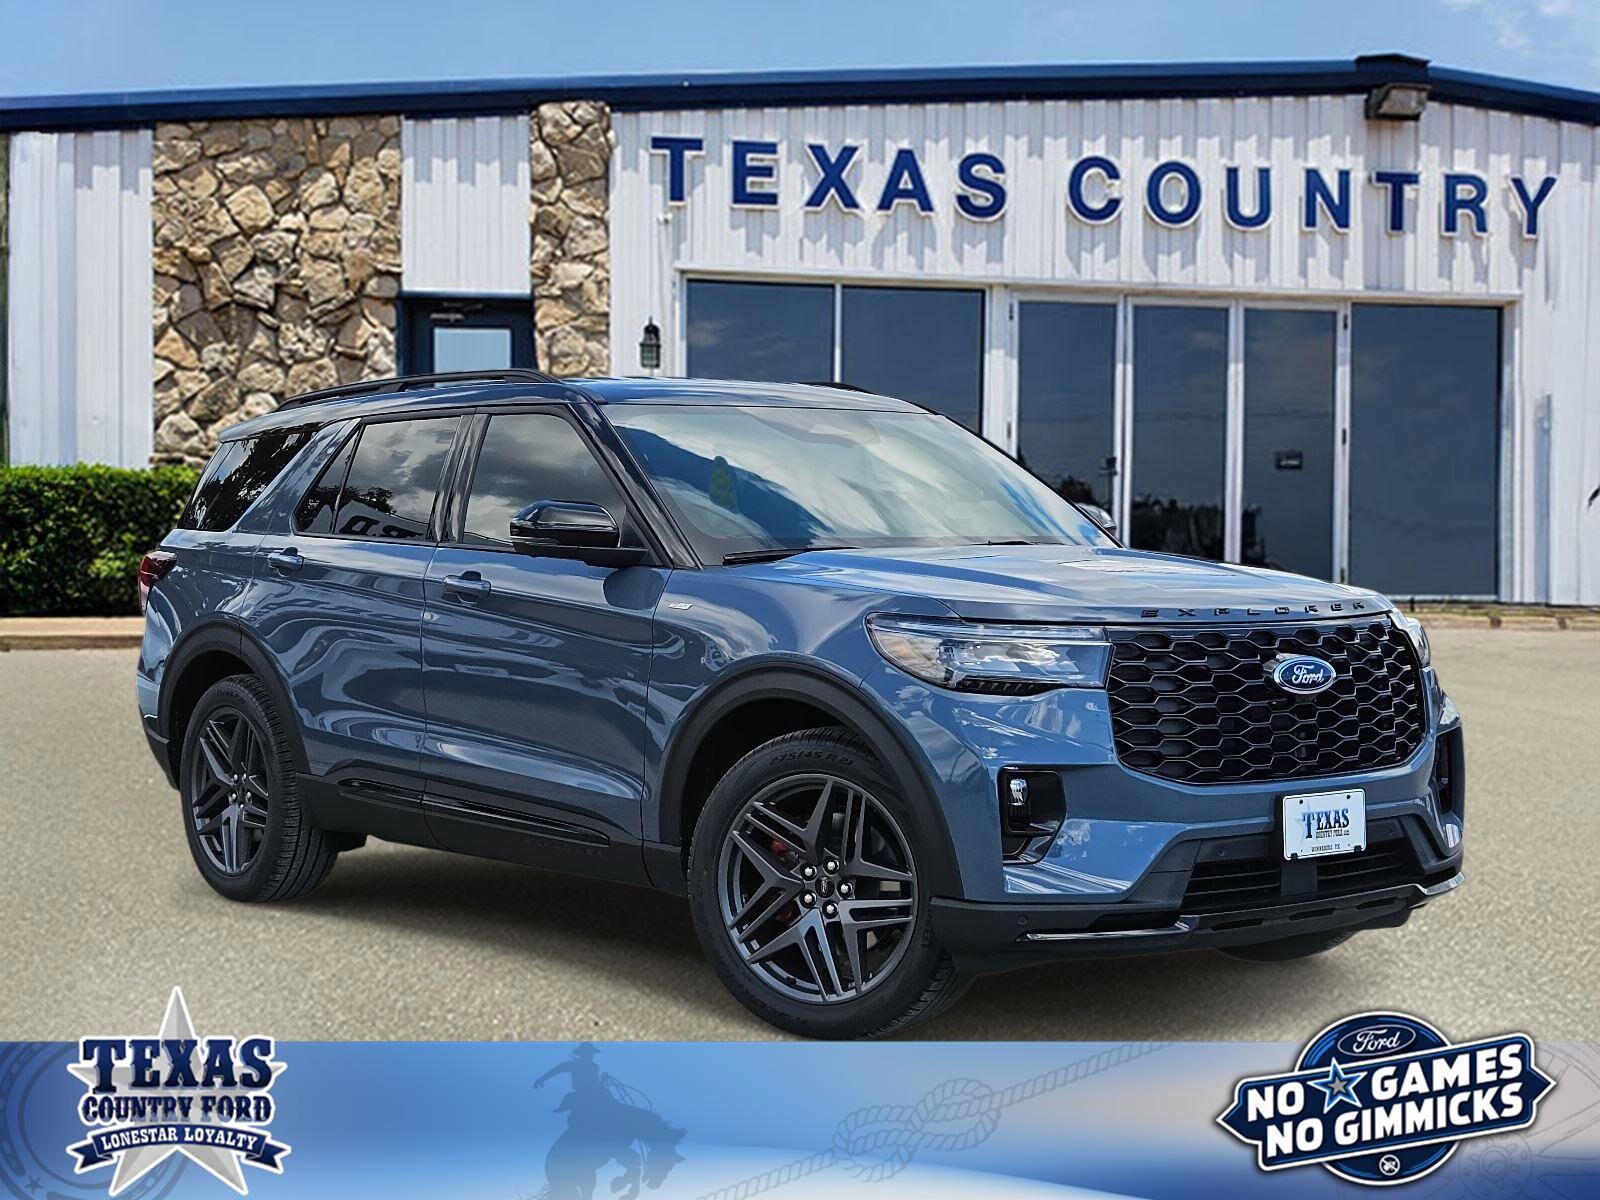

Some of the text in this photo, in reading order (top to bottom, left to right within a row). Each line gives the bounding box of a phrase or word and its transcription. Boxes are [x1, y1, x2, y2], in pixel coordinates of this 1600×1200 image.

[650, 135, 1558, 239] TEXAS COUNTRY
[1140, 601, 1365, 618] EXPLORER
[1291, 664, 1324, 685] Ford
[1301, 808, 1350, 839] TEXAS
